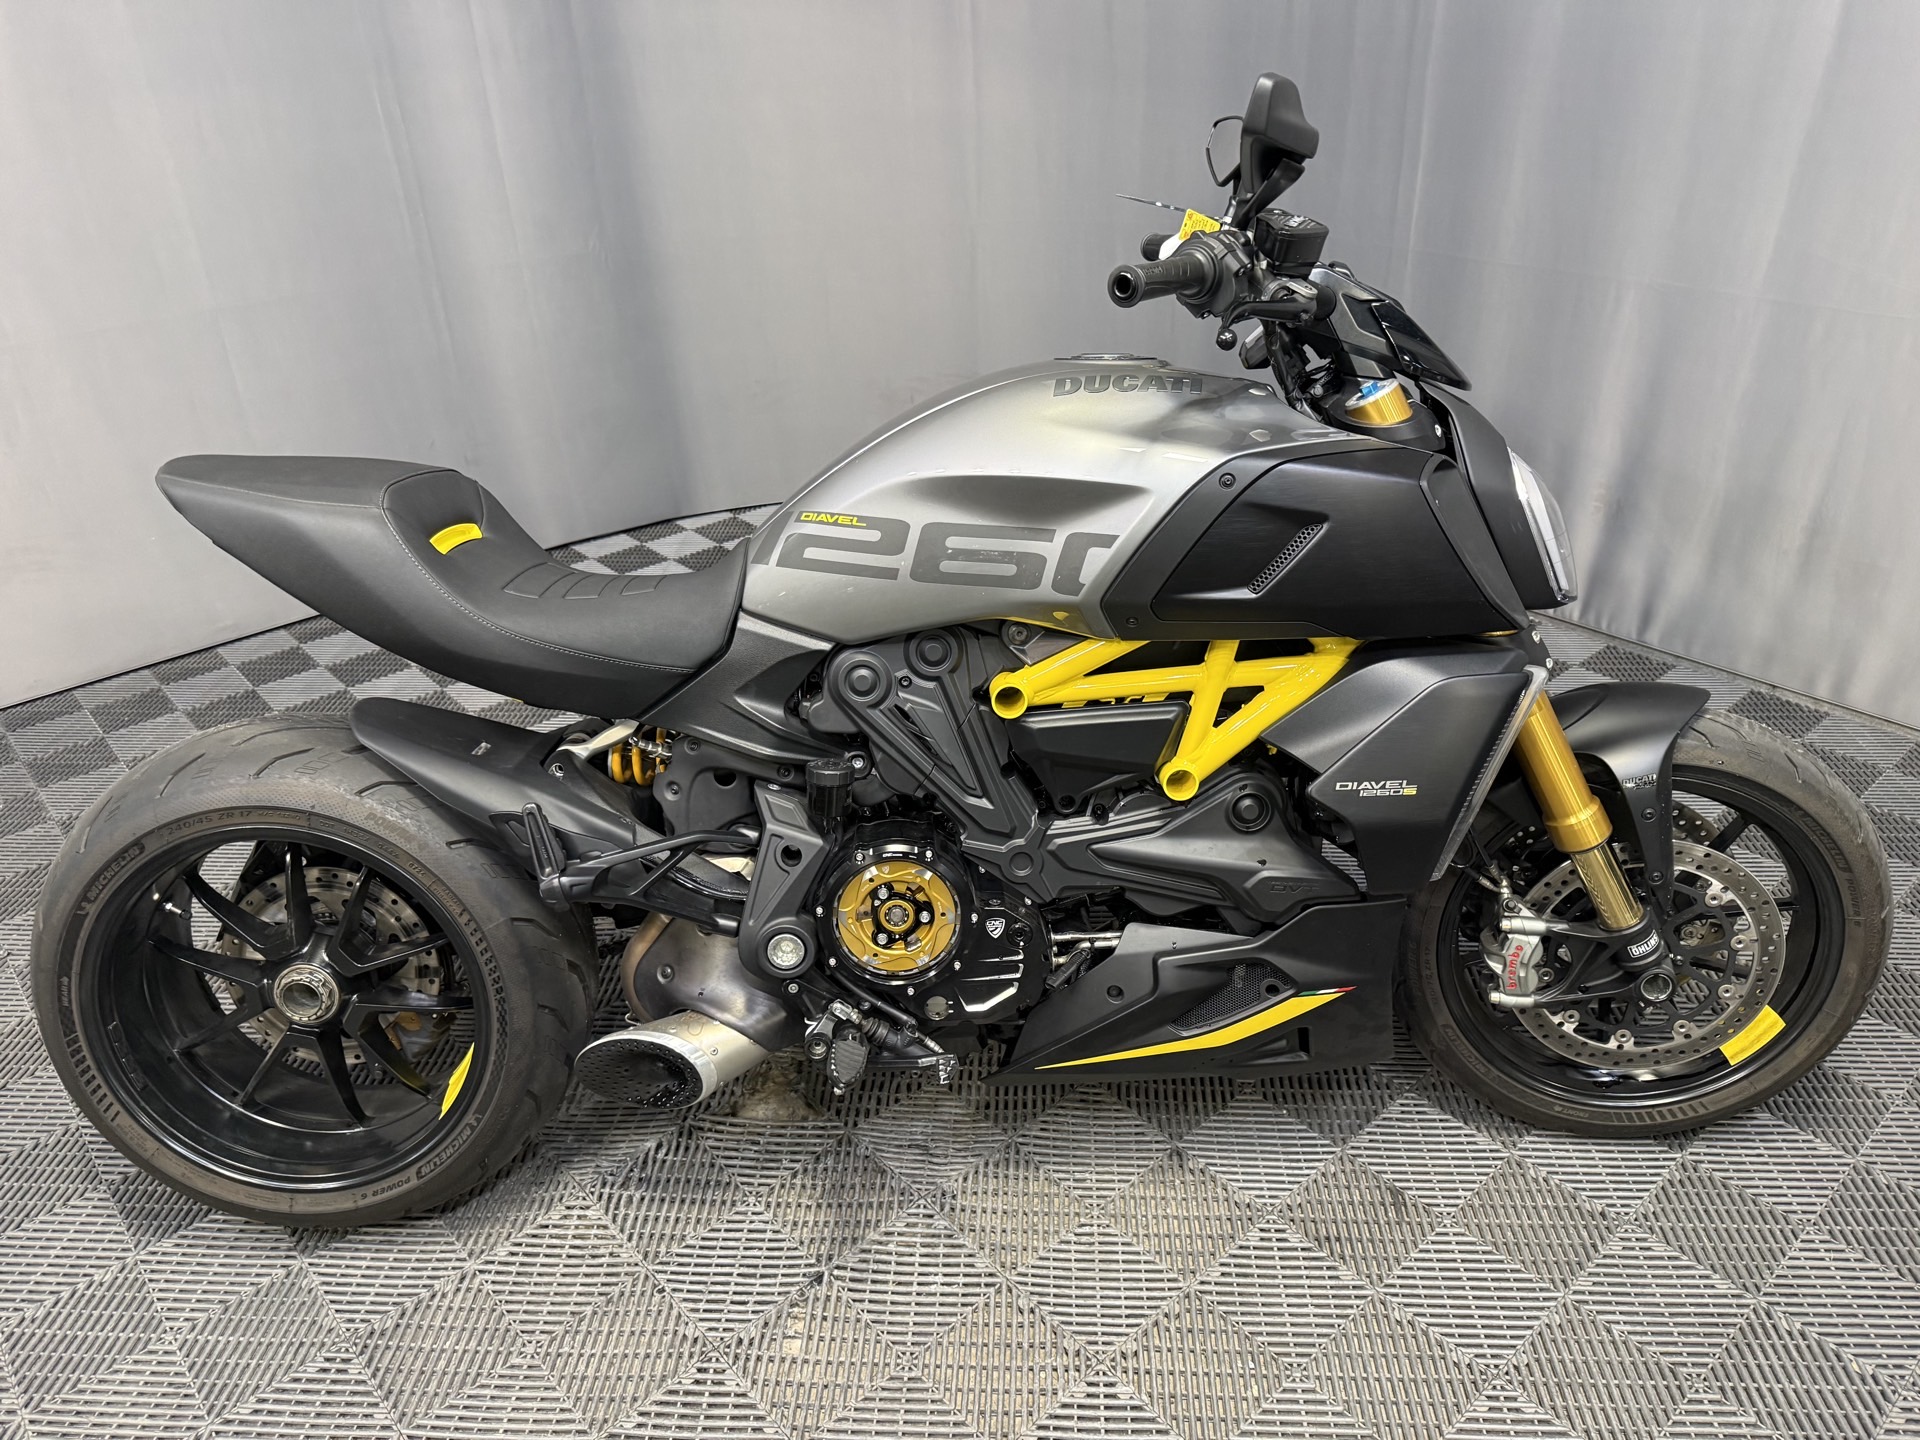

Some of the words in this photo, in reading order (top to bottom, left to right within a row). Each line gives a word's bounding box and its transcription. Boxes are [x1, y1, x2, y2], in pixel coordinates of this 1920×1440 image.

[1053, 374, 1203, 397] DUCATI
[800, 511, 867, 527] DIAVEL
[1335, 779, 1418, 791] DIAVEL
[168, 815, 213, 836] 240/45
[217, 811, 235, 821] ZR
[239, 810, 253, 818] 17
[86, 845, 142, 901] MICHELIN
[1505, 944, 1524, 990] brembo
[421, 1125, 472, 1176] MICHELIN
[371, 1175, 411, 1198] POWER
